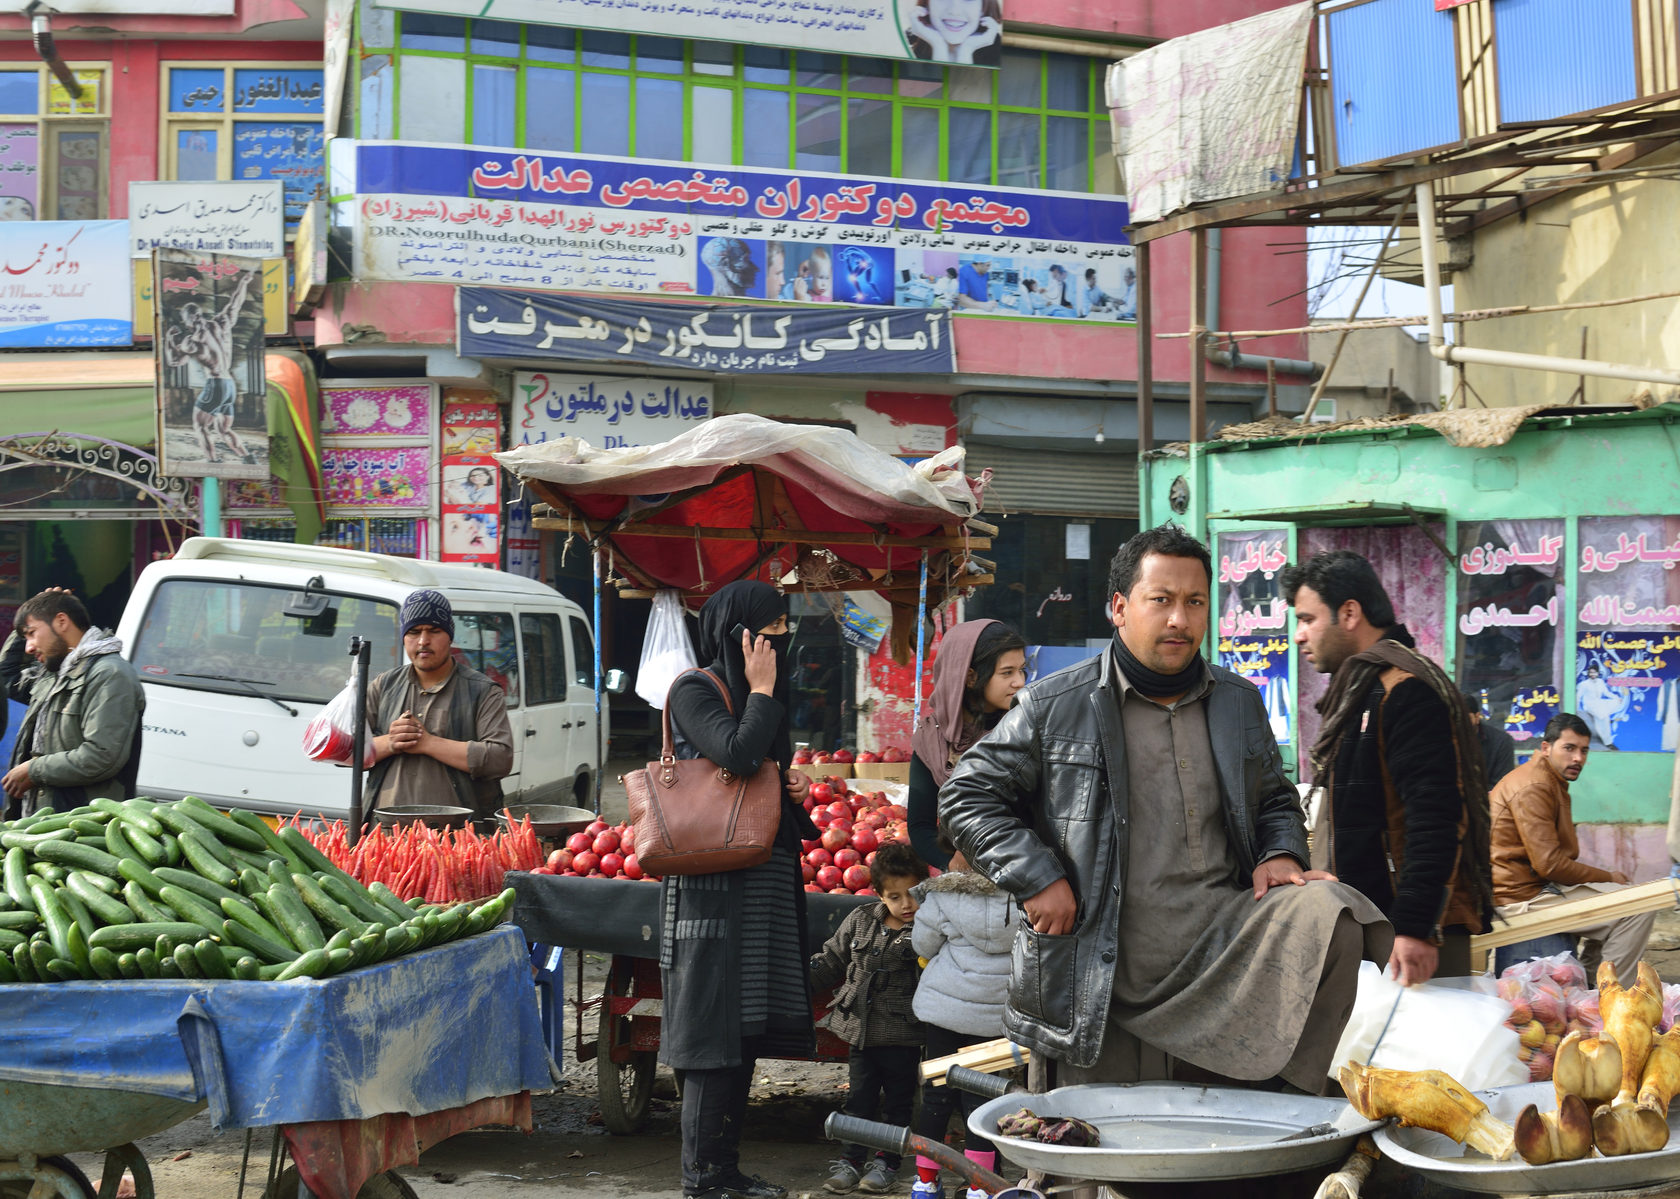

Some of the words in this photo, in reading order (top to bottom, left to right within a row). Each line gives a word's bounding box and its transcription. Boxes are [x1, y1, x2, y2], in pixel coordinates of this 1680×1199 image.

[473, 156, 593, 193] عدالت
[601, 171, 748, 207] متخصص
[756, 178, 917, 226] دوکتوران
[924, 197, 1030, 233] مجتمع
[451, 270, 464, 278] 4
[541, 275, 552, 285] 8
[467, 297, 610, 349] معرفت
[617, 316, 652, 354] در
[659, 311, 792, 357] کانکور
[800, 312, 944, 361] آمادگی
[691, 351, 718, 368] دارد
[720, 352, 756, 370] جریان
[757, 352, 776, 370] نام
[776, 351, 799, 369] ثبت
[641, 385, 709, 419] عدالت
[387, 453, 405, 474] آب
[1461, 535, 1563, 574] گلدوزی
[1219, 597, 1289, 637] گلدوزی
[1460, 596, 1558, 635] احمدی
[142, 724, 187, 736] STANA
